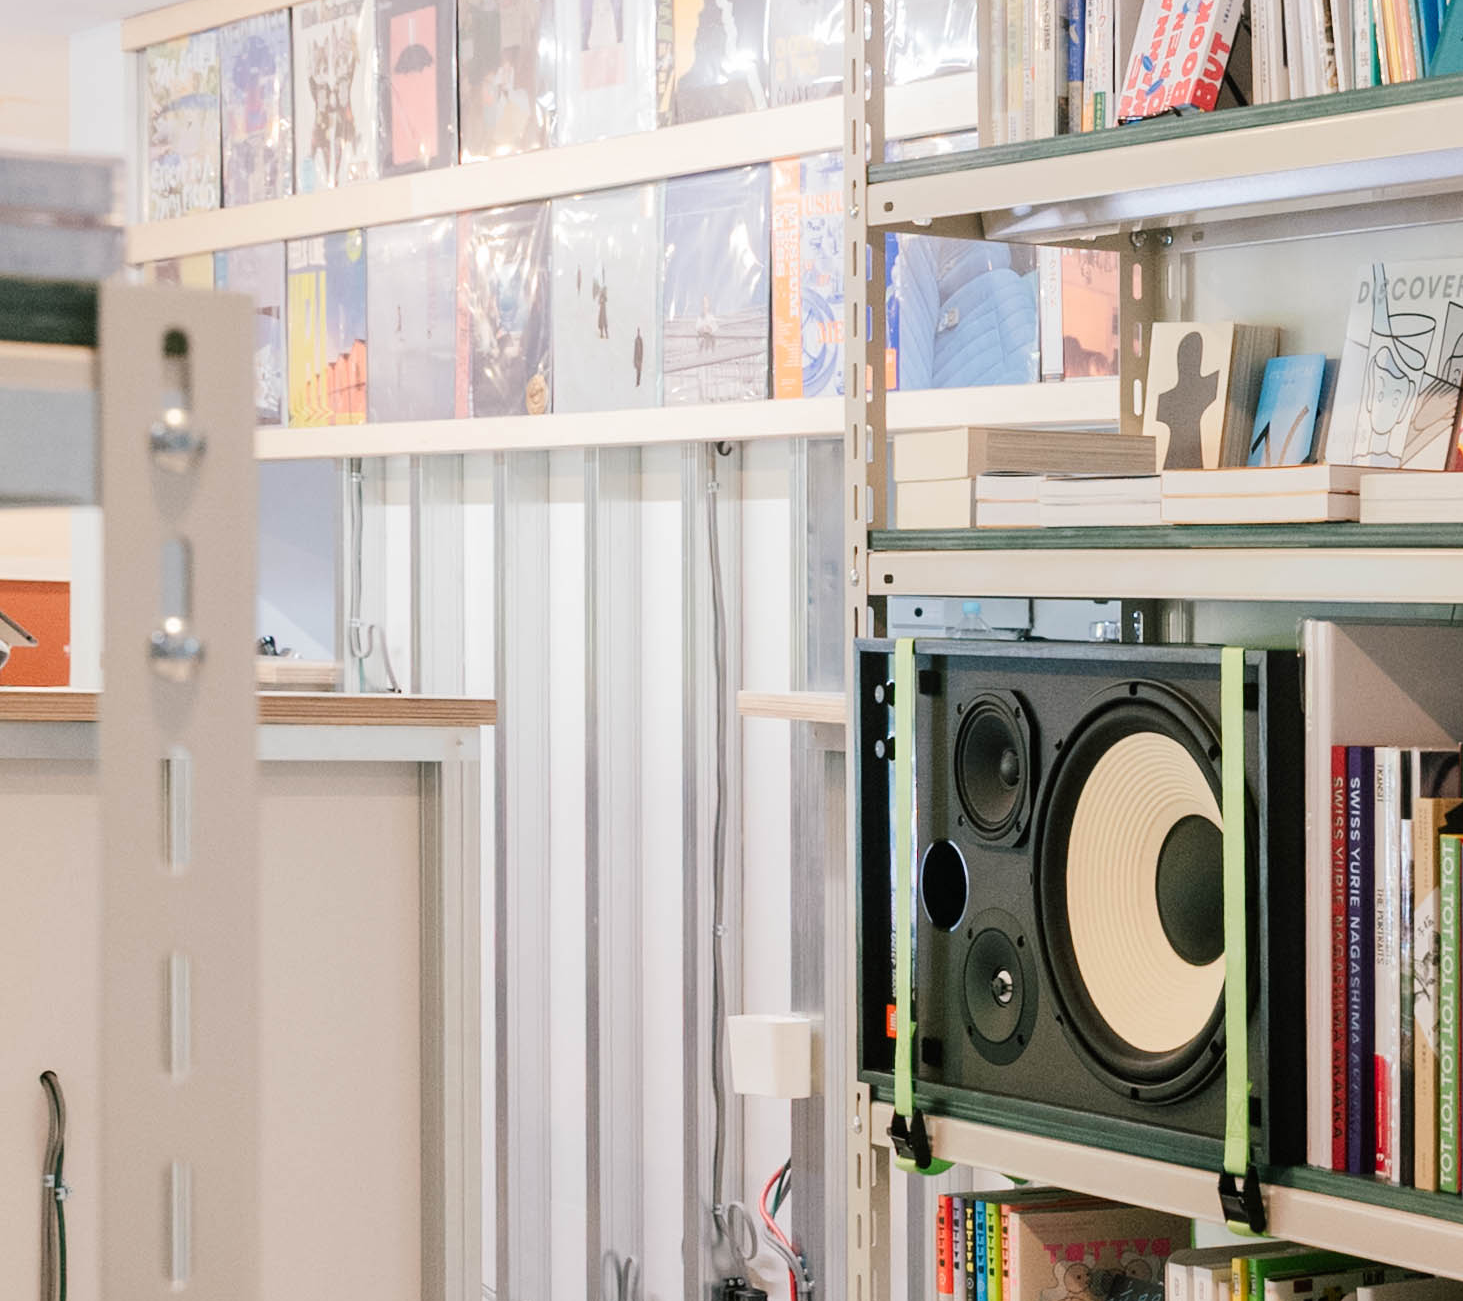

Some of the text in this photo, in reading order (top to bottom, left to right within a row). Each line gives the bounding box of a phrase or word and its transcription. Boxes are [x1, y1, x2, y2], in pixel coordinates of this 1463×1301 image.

[1191, 32, 1232, 113] BUT
[1332, 777, 1345, 840] SWISS
[1350, 777, 1361, 841] SWISS
[1333, 847, 1345, 906] YURIE
[1350, 847, 1361, 908] YURIE
[1332, 915, 1345, 1043] NAGASHIMA
[1350, 916, 1361, 1044] NAGASHIMA
